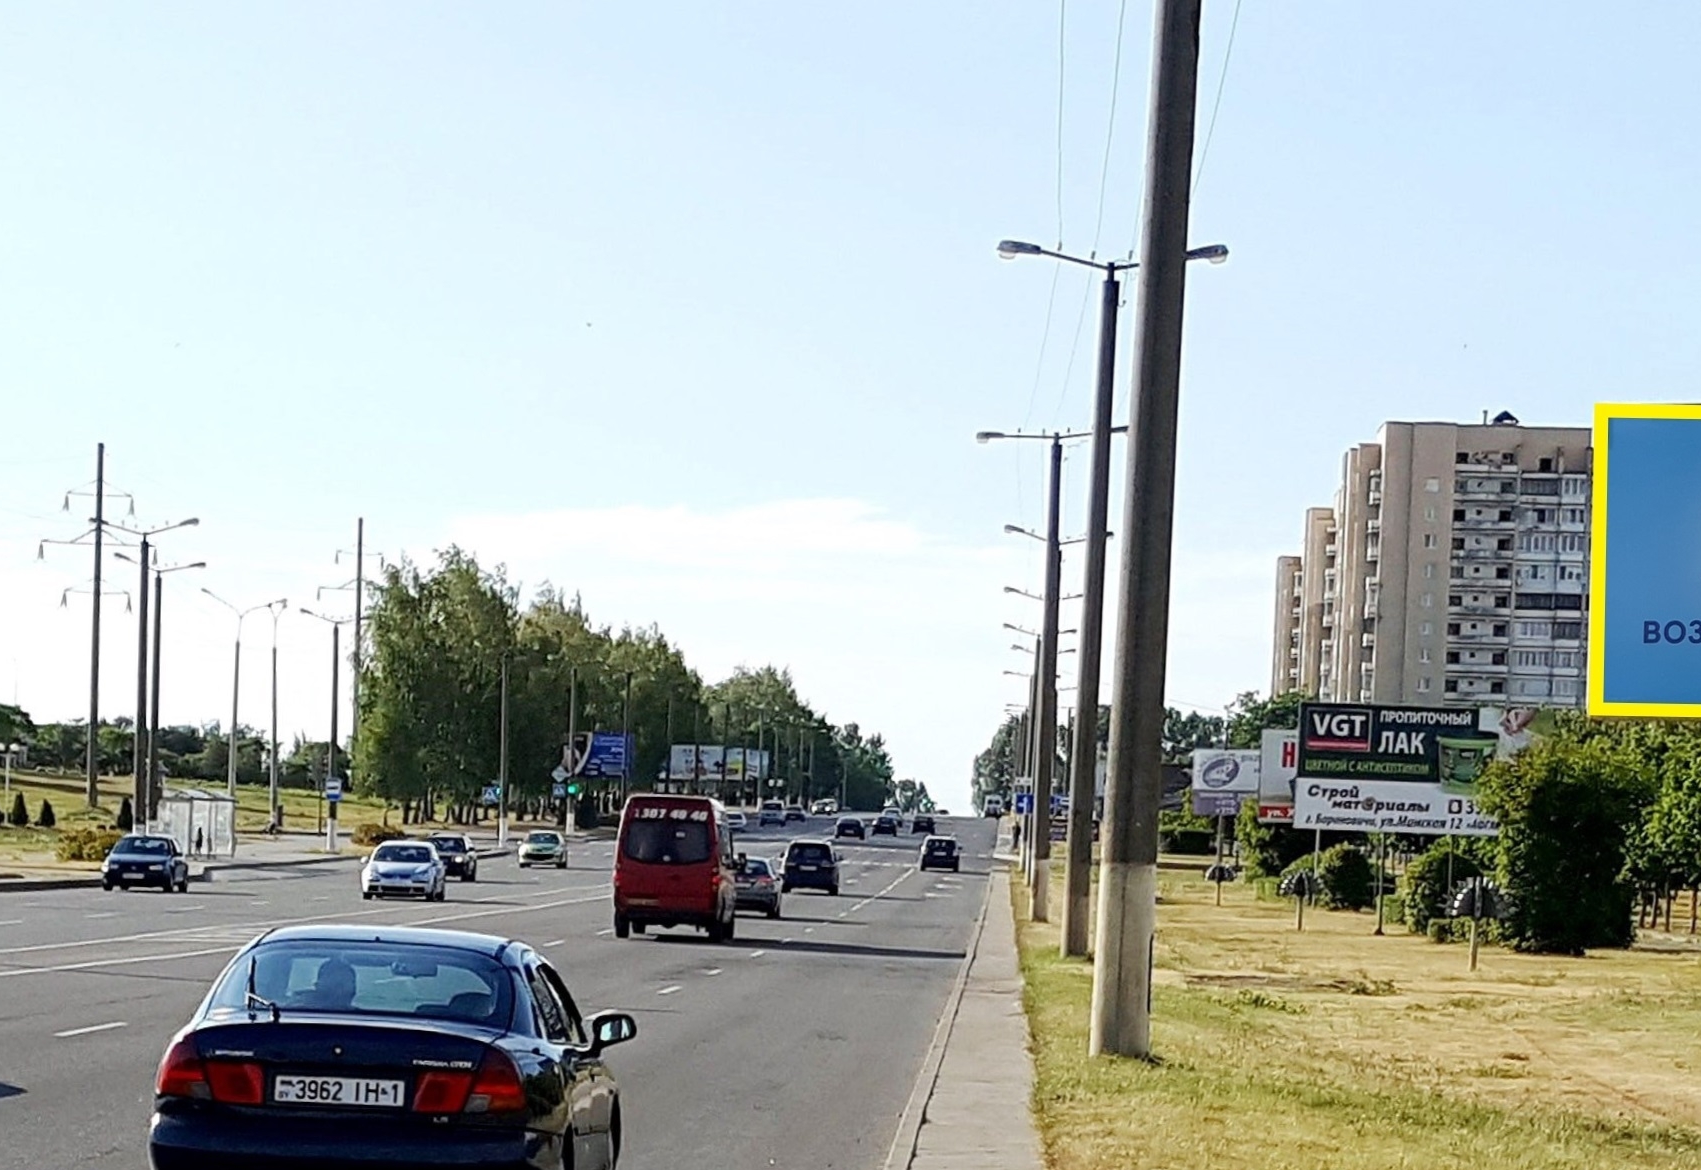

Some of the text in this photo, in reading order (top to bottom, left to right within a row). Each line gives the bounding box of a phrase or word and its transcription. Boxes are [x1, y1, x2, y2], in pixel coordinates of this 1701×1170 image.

[1312, 713, 1367, 737] VGT
[1379, 710, 1473, 726] ПРОПИТОЧНЫЙ
[1378, 731, 1426, 755] ЛАК
[1307, 784, 1360, 801] Строй
[295, 1080, 343, 1101] 3962
